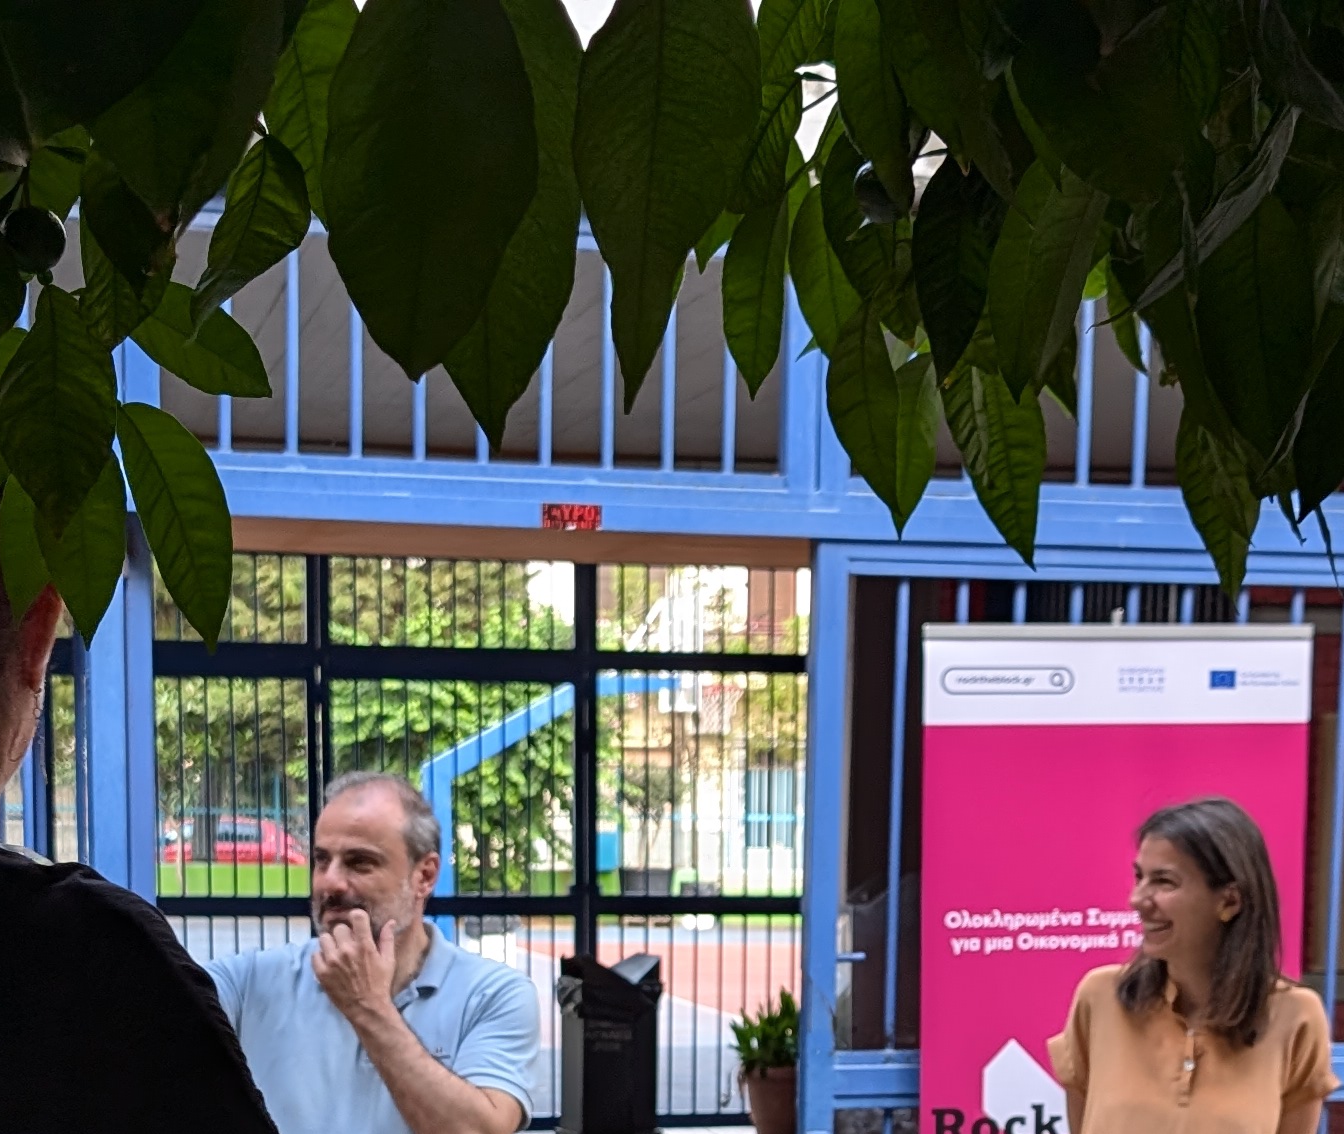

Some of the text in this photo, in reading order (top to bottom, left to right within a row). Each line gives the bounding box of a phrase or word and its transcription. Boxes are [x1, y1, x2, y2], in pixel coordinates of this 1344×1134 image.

[944, 908, 1083, 930] Ολοκληρωμένα
[951, 936, 980, 955] για
[984, 935, 1013, 955] μια
[1016, 930, 1119, 952] Οικονομικά
